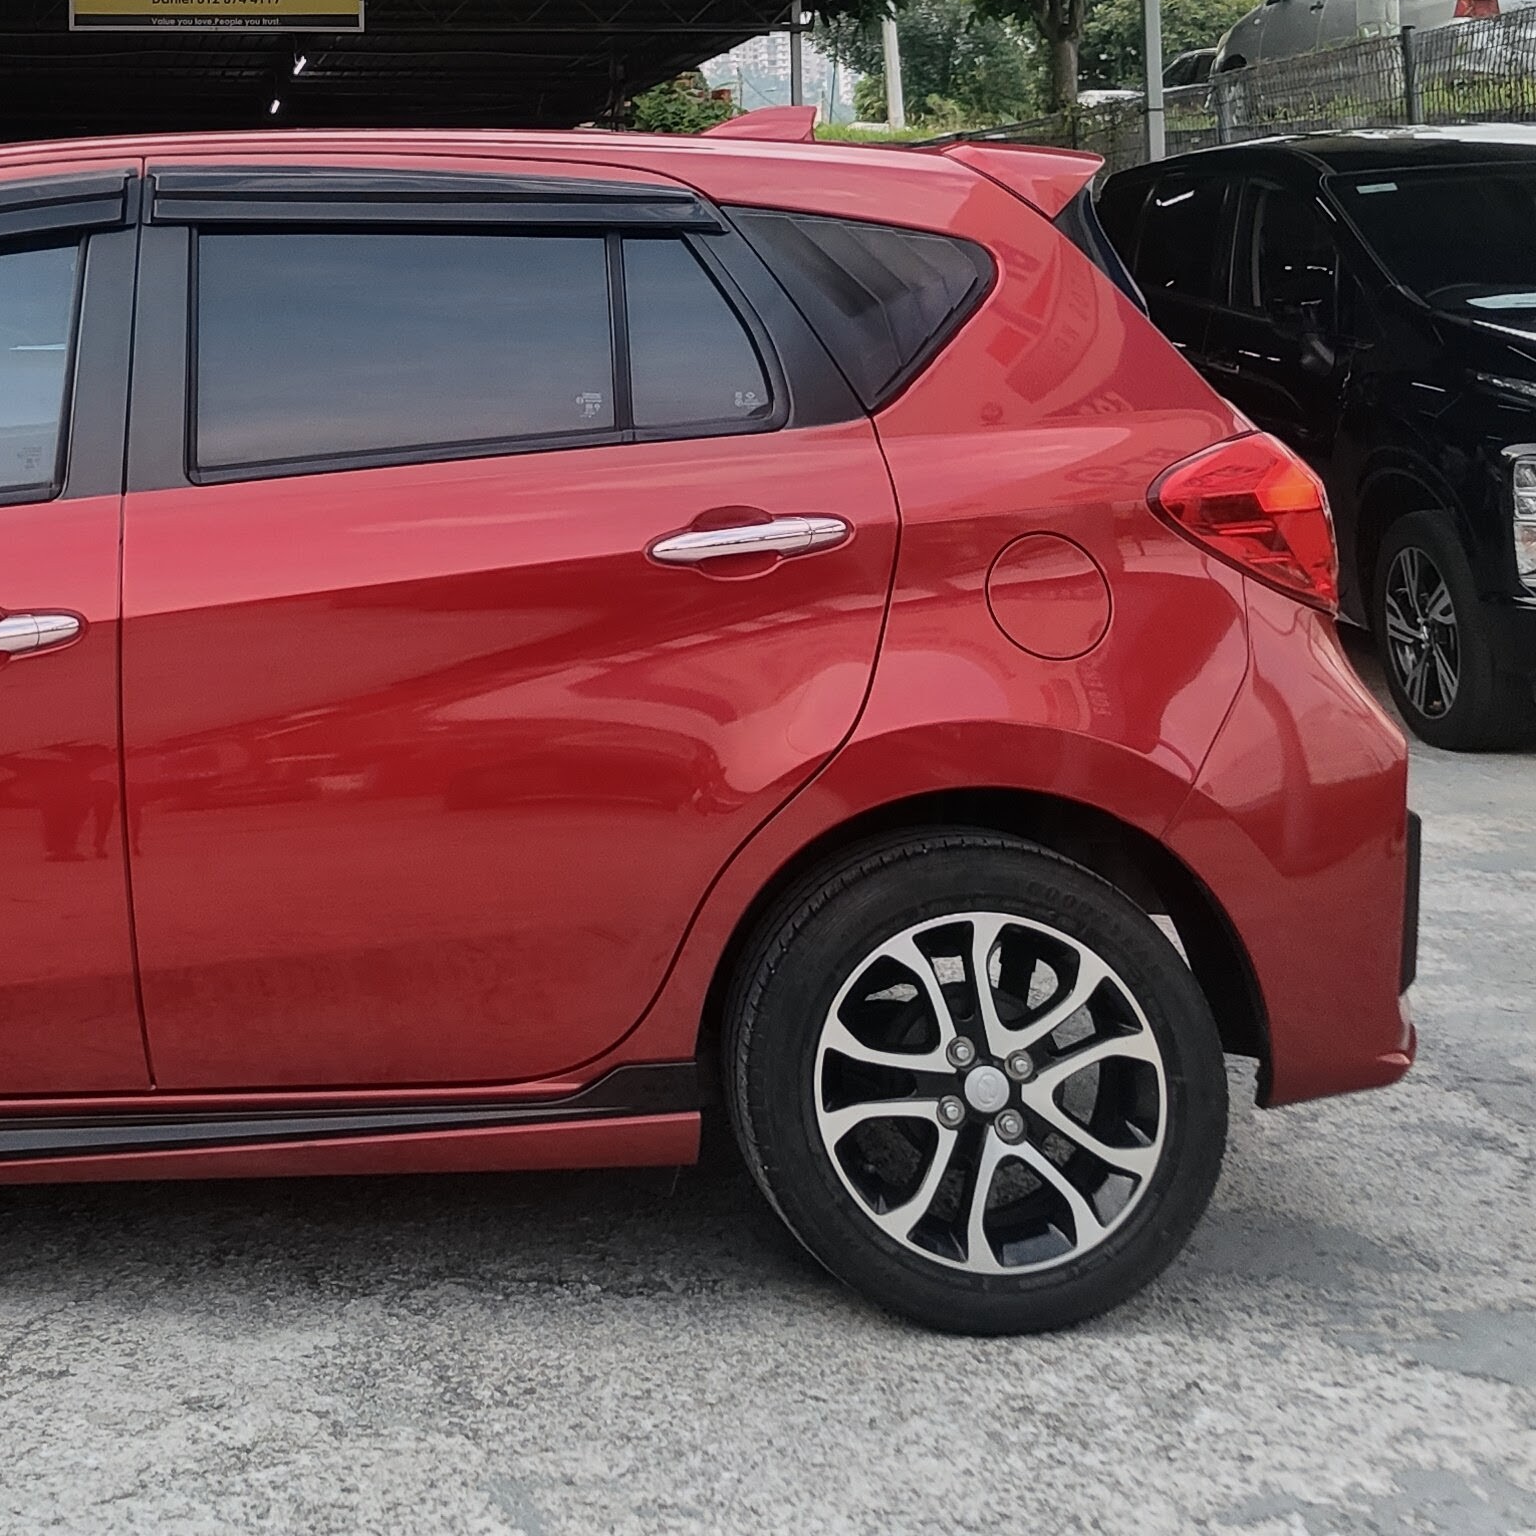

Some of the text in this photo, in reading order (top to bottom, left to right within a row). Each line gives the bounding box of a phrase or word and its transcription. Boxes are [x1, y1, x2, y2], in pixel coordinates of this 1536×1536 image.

[151, 17, 176, 25] Value
[177, 19, 193, 27] you
[244, 19, 261, 27] you
